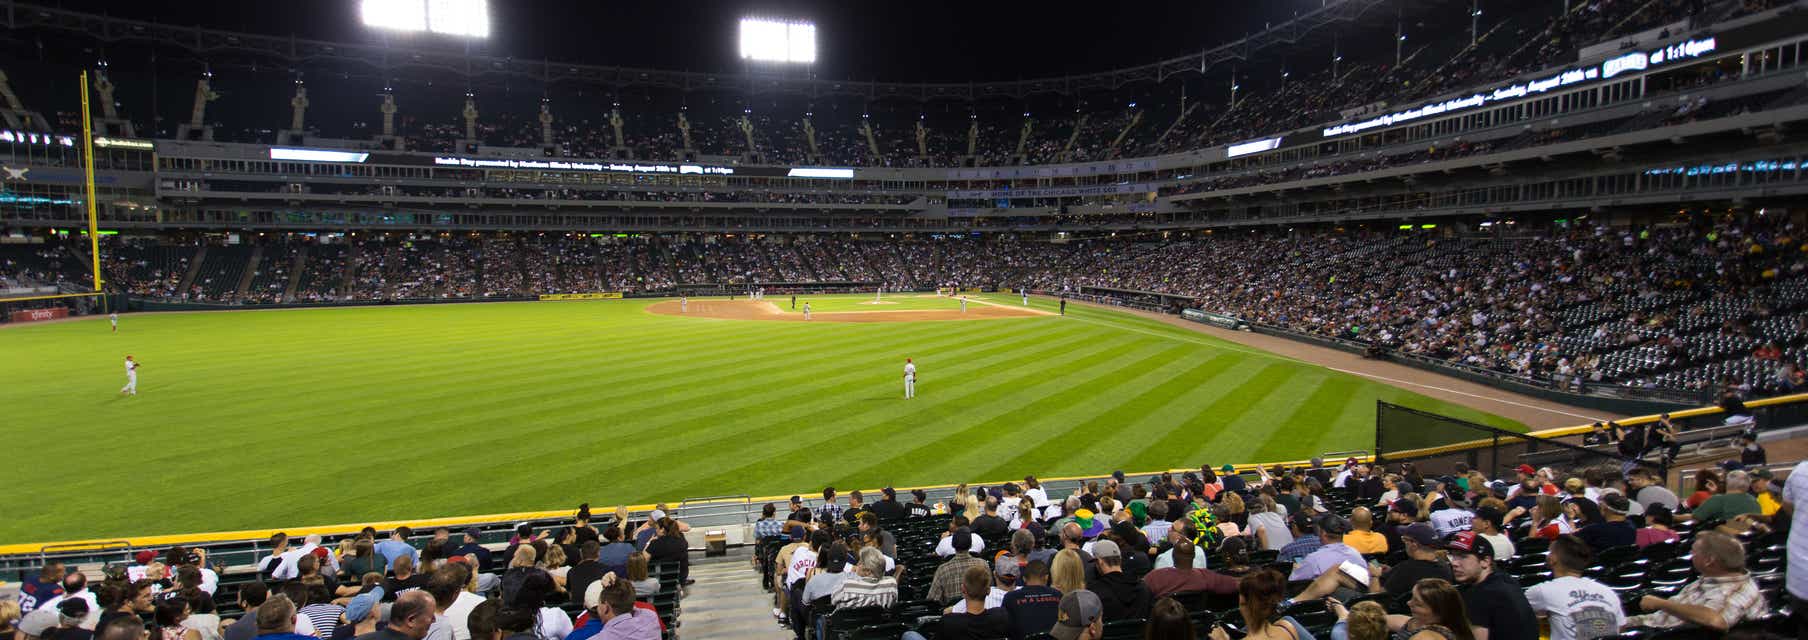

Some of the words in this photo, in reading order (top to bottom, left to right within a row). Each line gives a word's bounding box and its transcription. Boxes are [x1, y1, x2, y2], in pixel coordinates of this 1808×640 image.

[1527, 75, 1560, 92] August
[1650, 49, 1664, 64] at
[1667, 37, 1715, 60] 1:10pm
